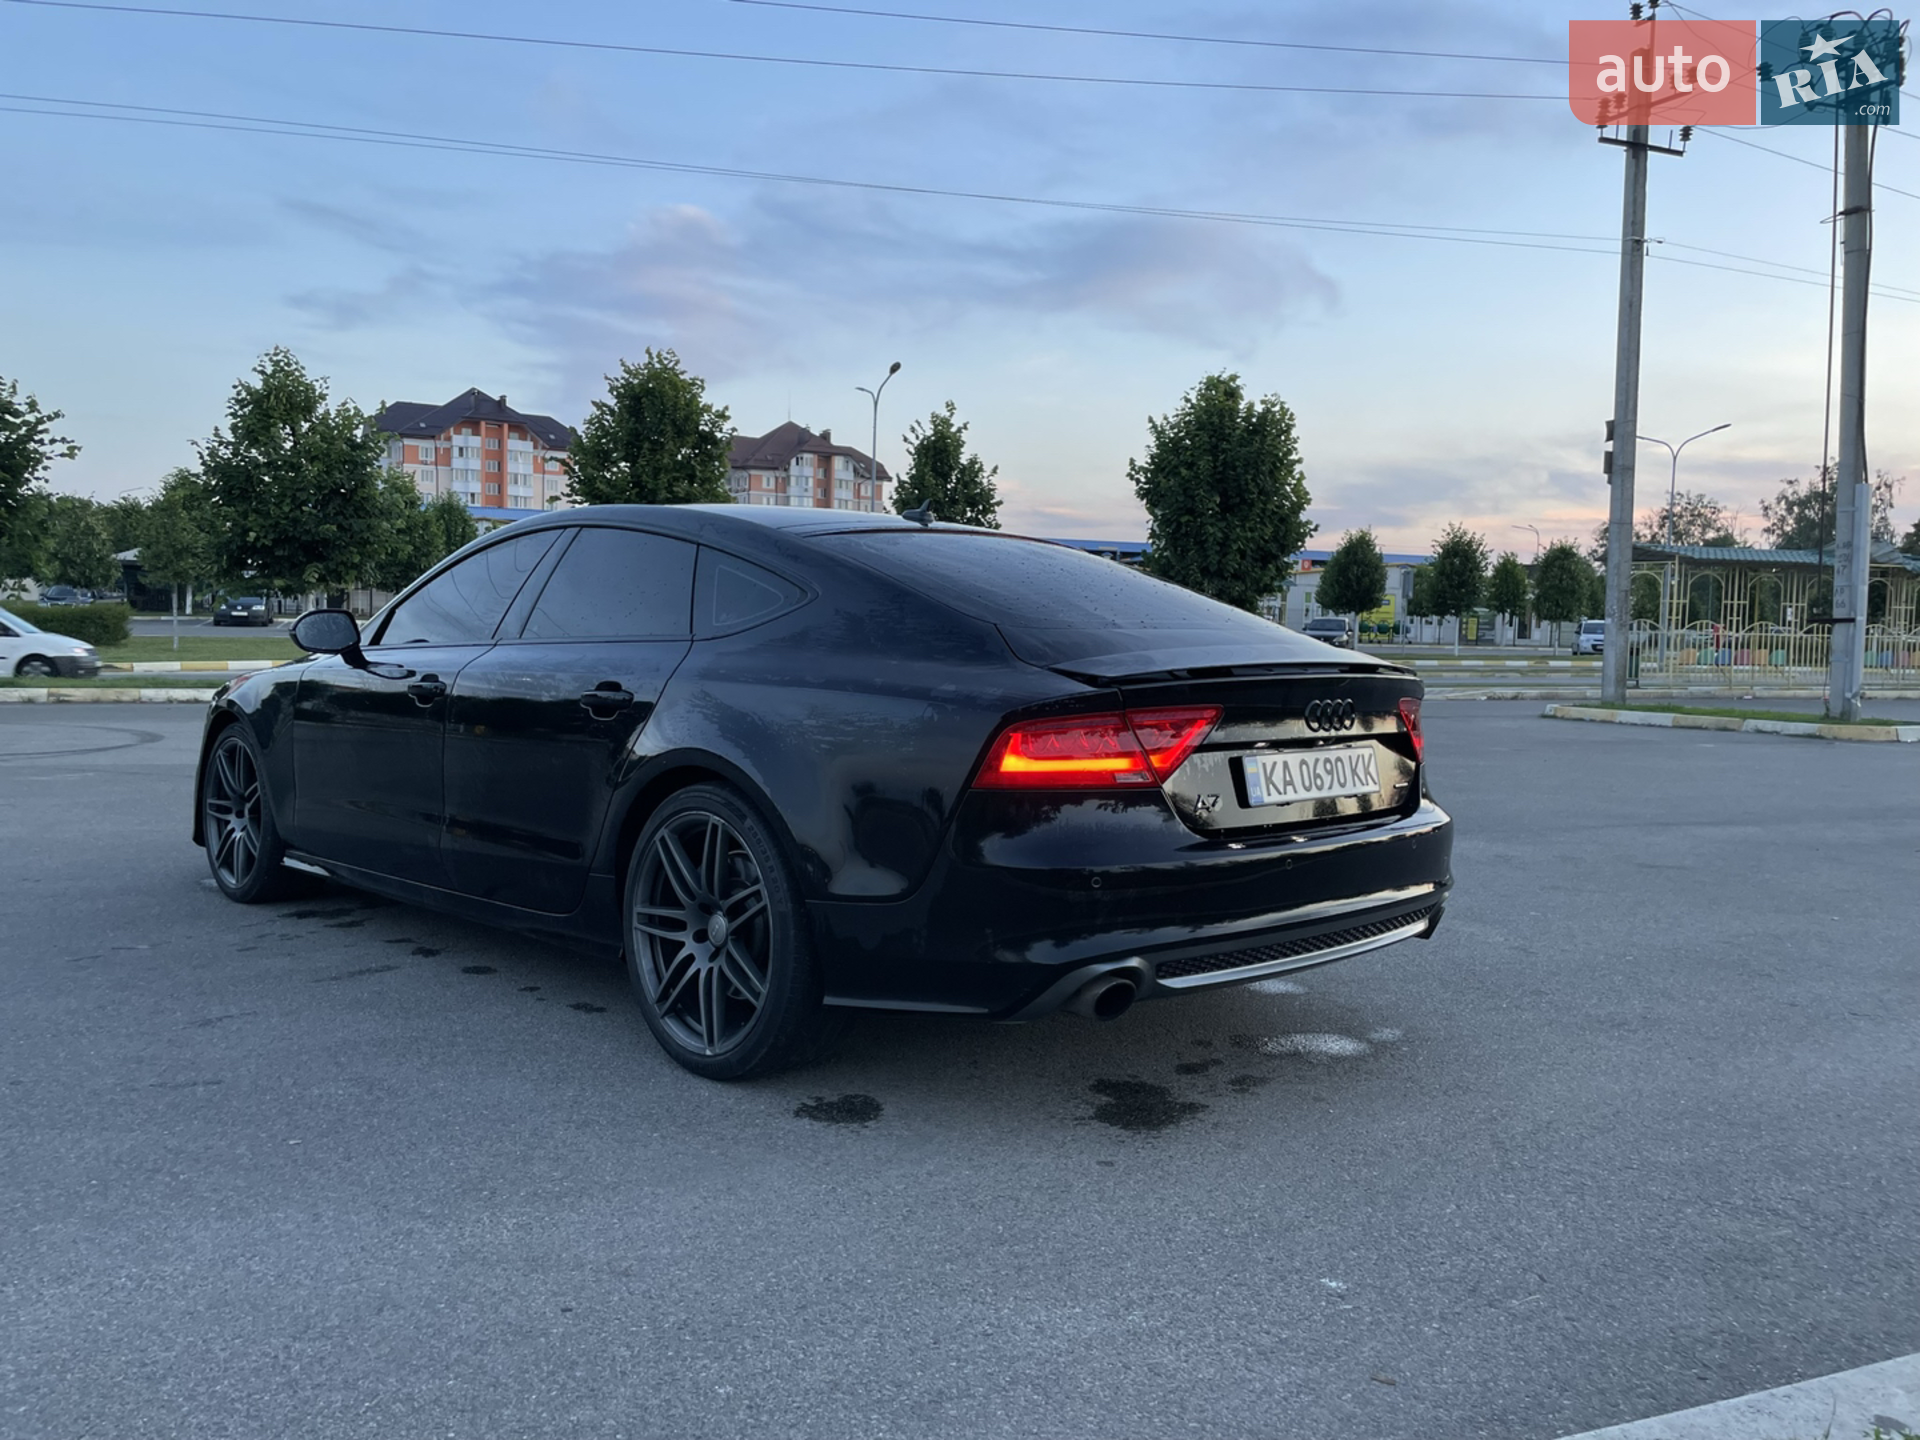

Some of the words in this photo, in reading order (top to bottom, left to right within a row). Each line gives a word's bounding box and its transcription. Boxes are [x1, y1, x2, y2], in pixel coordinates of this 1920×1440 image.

[1262, 760, 1298, 797] KA
[1299, 757, 1348, 793] 0690
[1348, 753, 1378, 788] KK
